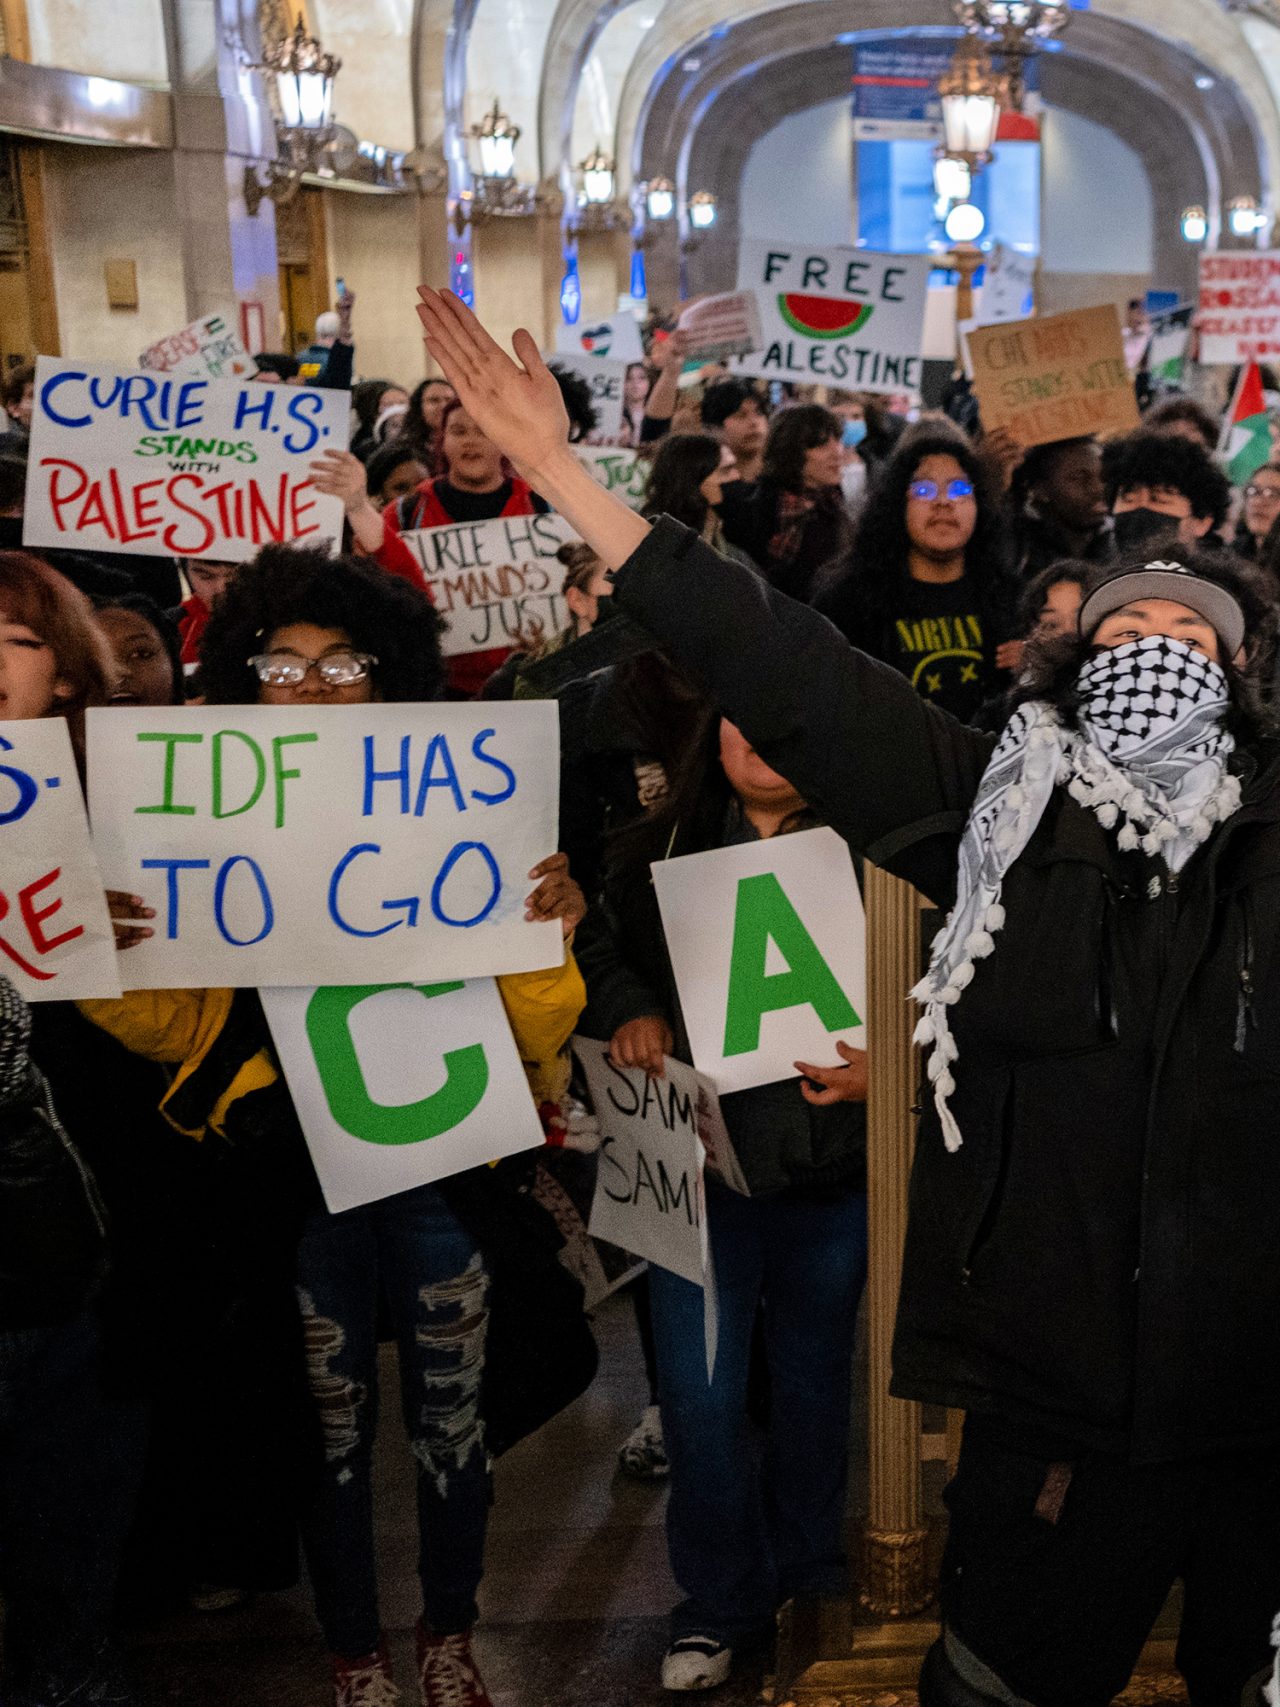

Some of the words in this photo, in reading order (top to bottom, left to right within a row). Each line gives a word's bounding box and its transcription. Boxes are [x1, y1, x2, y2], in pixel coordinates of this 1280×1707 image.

[764, 253, 907, 301] FREE
[738, 340, 921, 388] ALESTINE
[40, 371, 209, 432] CURIE
[233, 390, 330, 455] H.S.
[133, 435, 259, 464] STANDS
[40, 457, 321, 554] PALESTINE
[167, 460, 221, 474] WITH
[401, 524, 492, 576] URIE
[504, 513, 563, 560] HS
[133, 729, 319, 829] IDF
[362, 728, 518, 818] HAS
[141, 855, 275, 946] TO
[327, 841, 502, 938] GO
[722, 872, 864, 1059] A
[305, 980, 490, 1147] C
